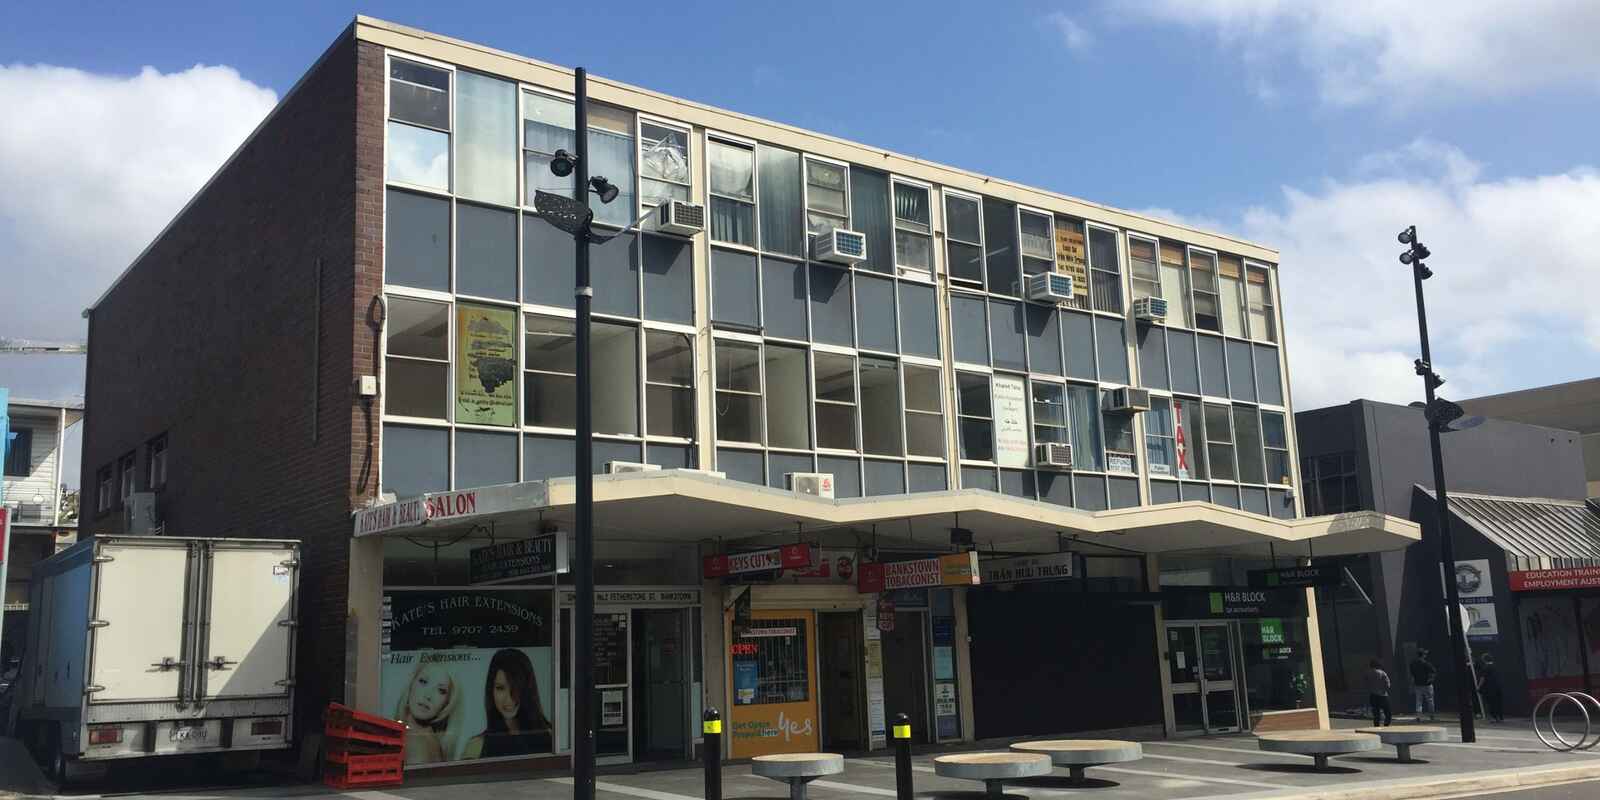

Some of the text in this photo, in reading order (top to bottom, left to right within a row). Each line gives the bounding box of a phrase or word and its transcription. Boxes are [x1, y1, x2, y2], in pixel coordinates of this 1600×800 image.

[1174, 400, 1188, 470] TAX
[425, 493, 476, 521] SALON
[727, 555, 749, 570] KEYS
[886, 559, 940, 576] BANKSTOWN
[886, 574, 941, 588] TOBACCONIST
[1525, 569, 1572, 580] EDUCATION
[1523, 578, 1578, 589] EMPLOYMENT
[1225, 591, 1266, 602] H&R BLOCK
[391, 602, 435, 631] KATE'S
[440, 597, 470, 610] HAIR
[474, 596, 544, 626] EXTENSIONS
[451, 626, 482, 635] 9707
[1261, 633, 1285, 643] BLOCK
[730, 643, 758, 656] OPEN
[391, 653, 414, 664] Hair
